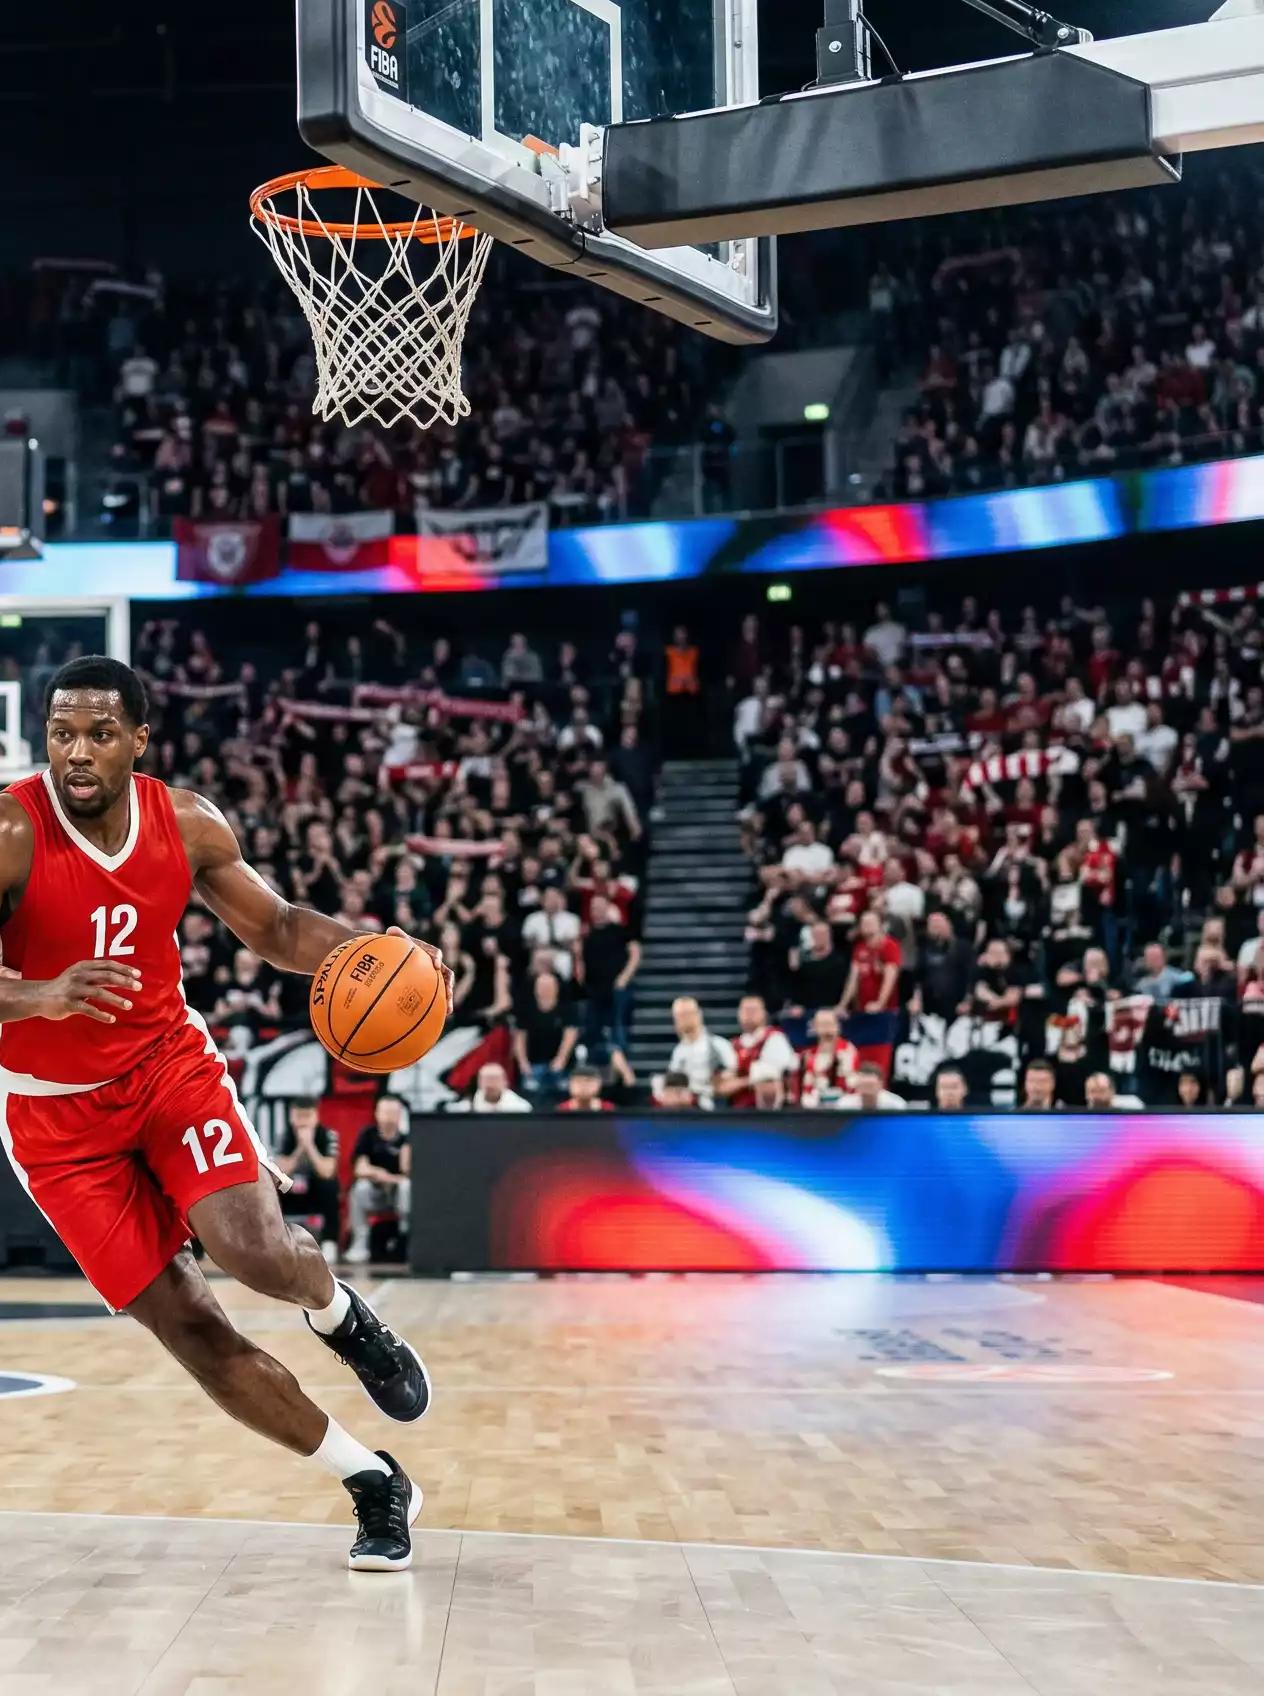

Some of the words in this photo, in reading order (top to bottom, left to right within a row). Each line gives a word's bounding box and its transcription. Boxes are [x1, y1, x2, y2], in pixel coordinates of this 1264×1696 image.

[371, 45, 398, 81] FIBA
[91, 904, 138, 958] 12
[313, 938, 357, 1005] SPALD
[350, 953, 379, 983] FIBA
[181, 1118, 244, 1174] 12
